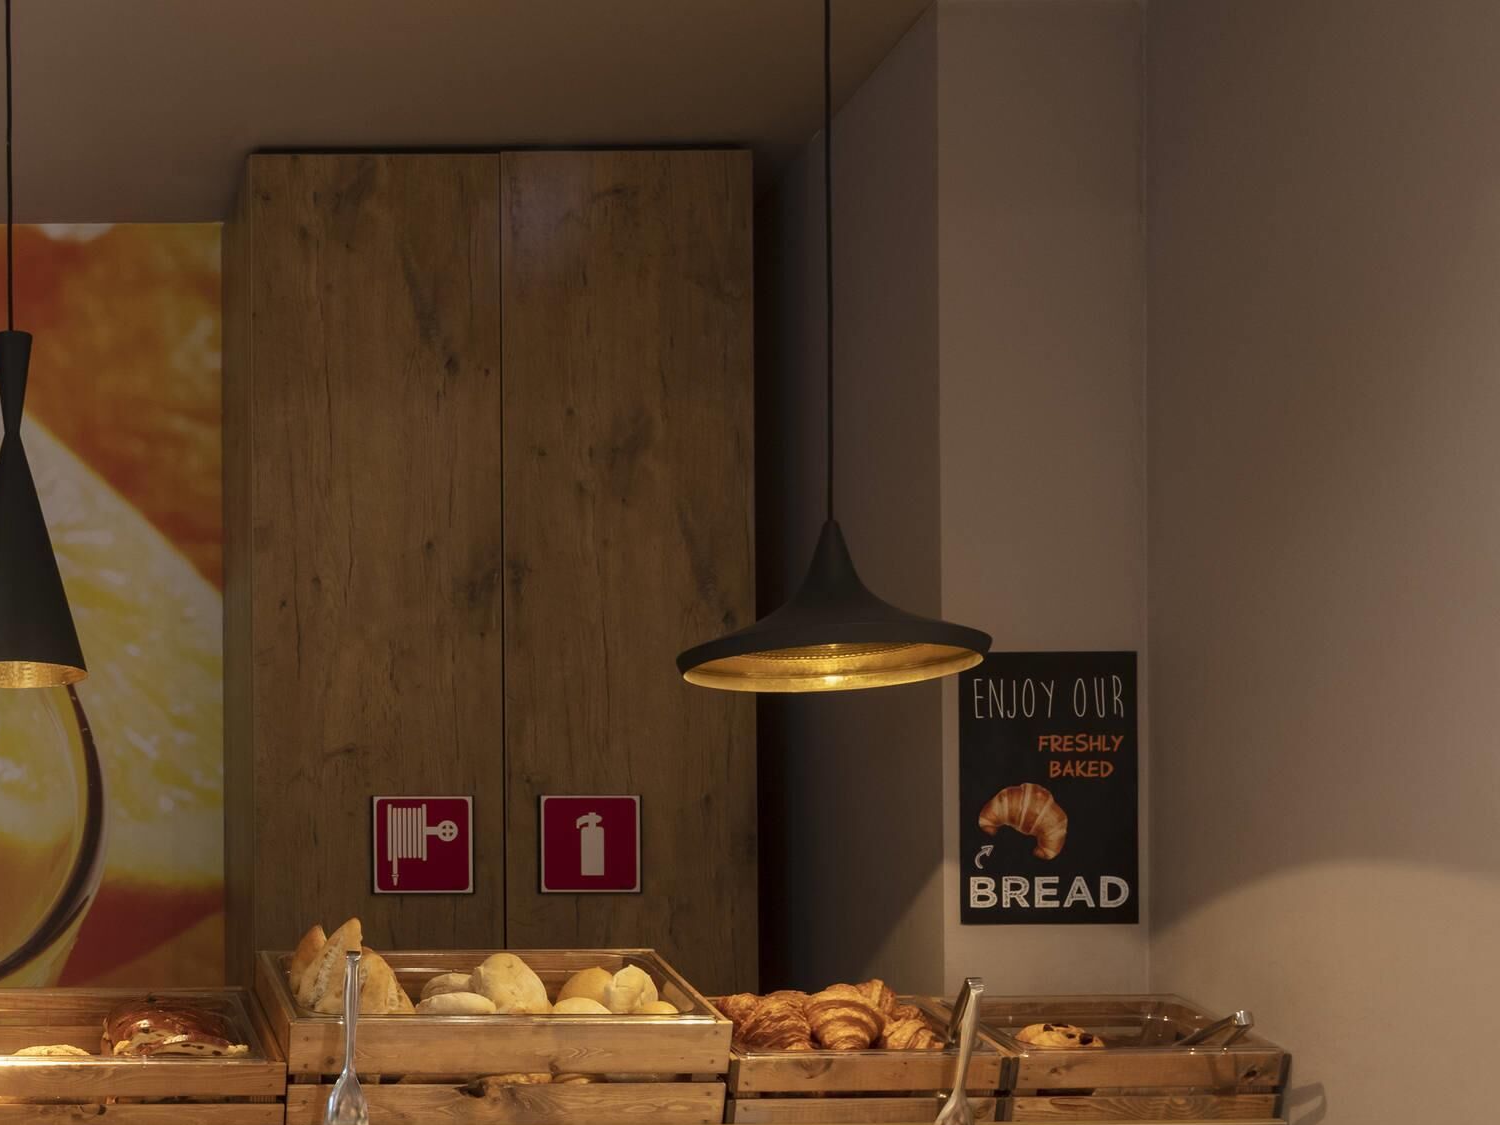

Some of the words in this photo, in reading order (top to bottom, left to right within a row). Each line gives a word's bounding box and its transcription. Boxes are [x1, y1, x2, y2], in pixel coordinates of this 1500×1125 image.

[973, 678, 1055, 719] ENJOY
[1073, 674, 1125, 719] OUR
[1037, 733, 1124, 753] FRESHLY
[1049, 760, 1114, 778] BAKED
[969, 875, 1130, 909] BREAD
